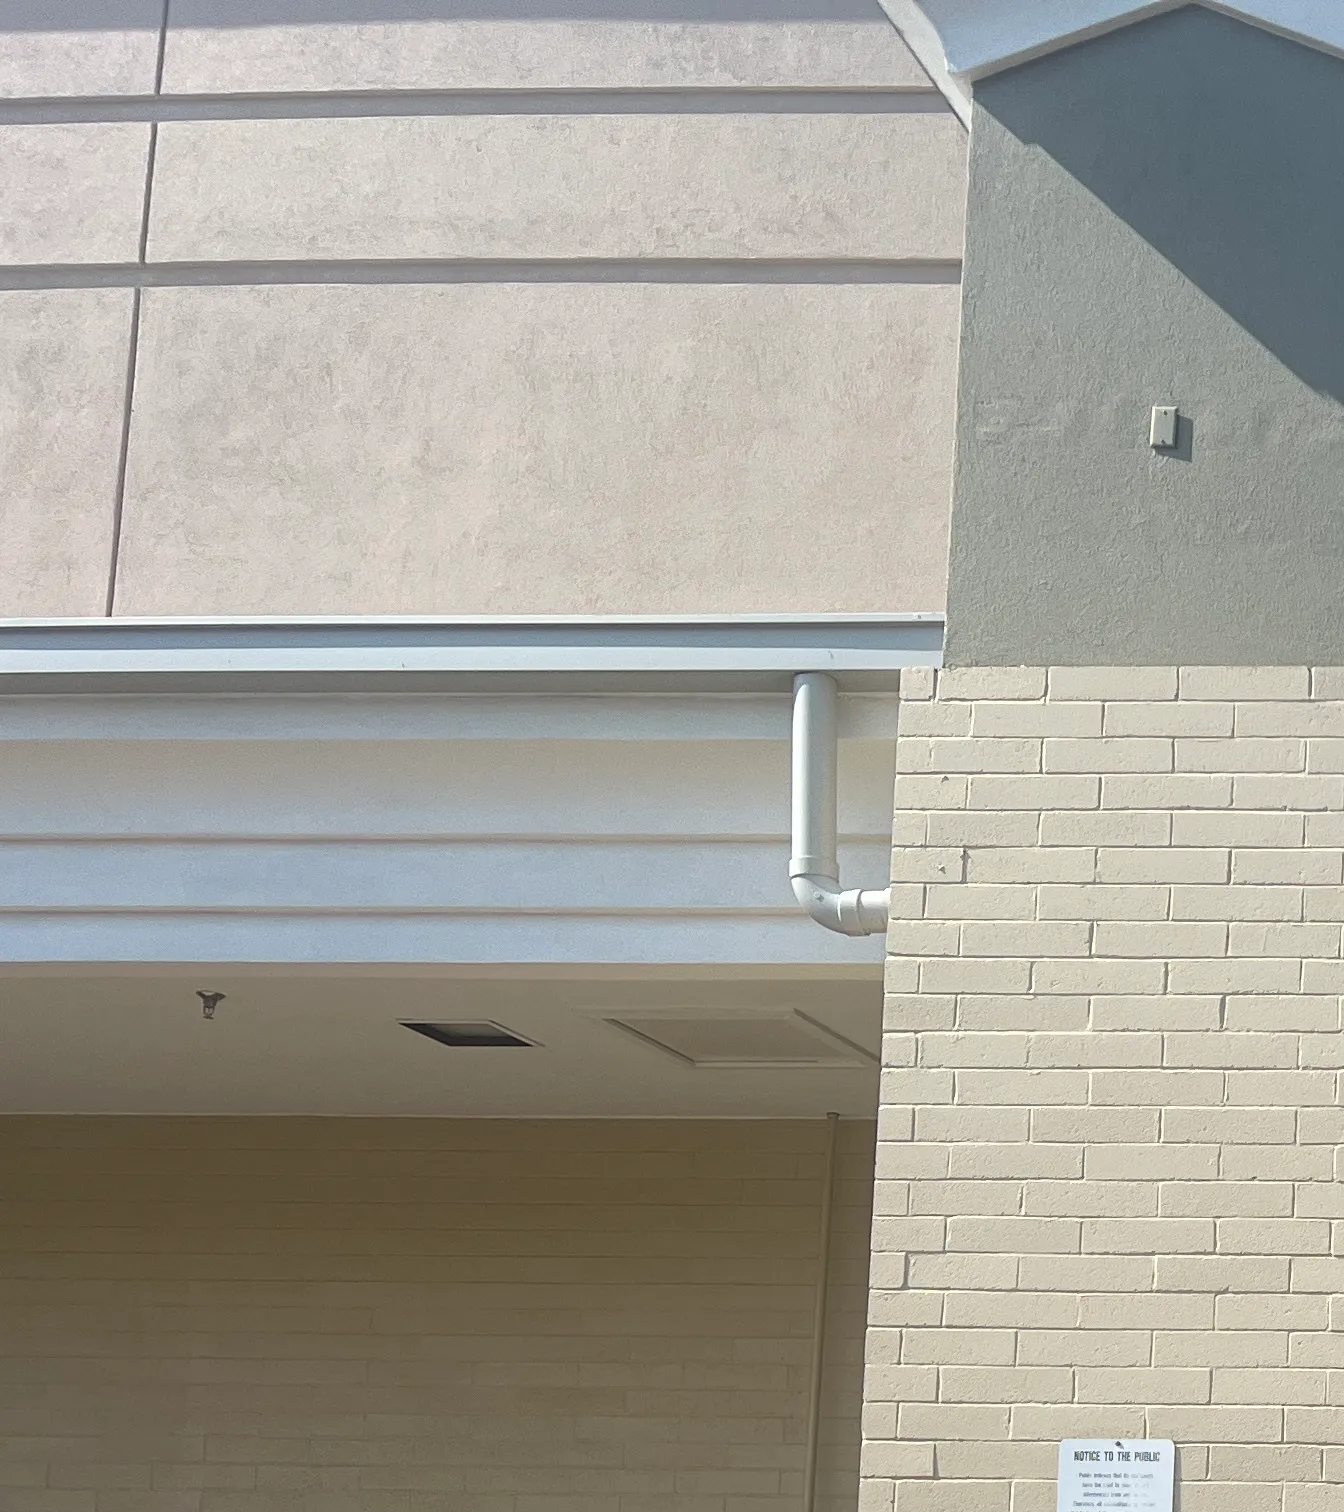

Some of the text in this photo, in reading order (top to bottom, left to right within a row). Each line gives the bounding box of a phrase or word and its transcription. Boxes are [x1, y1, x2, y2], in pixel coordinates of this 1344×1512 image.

[1073, 1450, 1160, 1462] NOTICE TO THE PUBLIC
